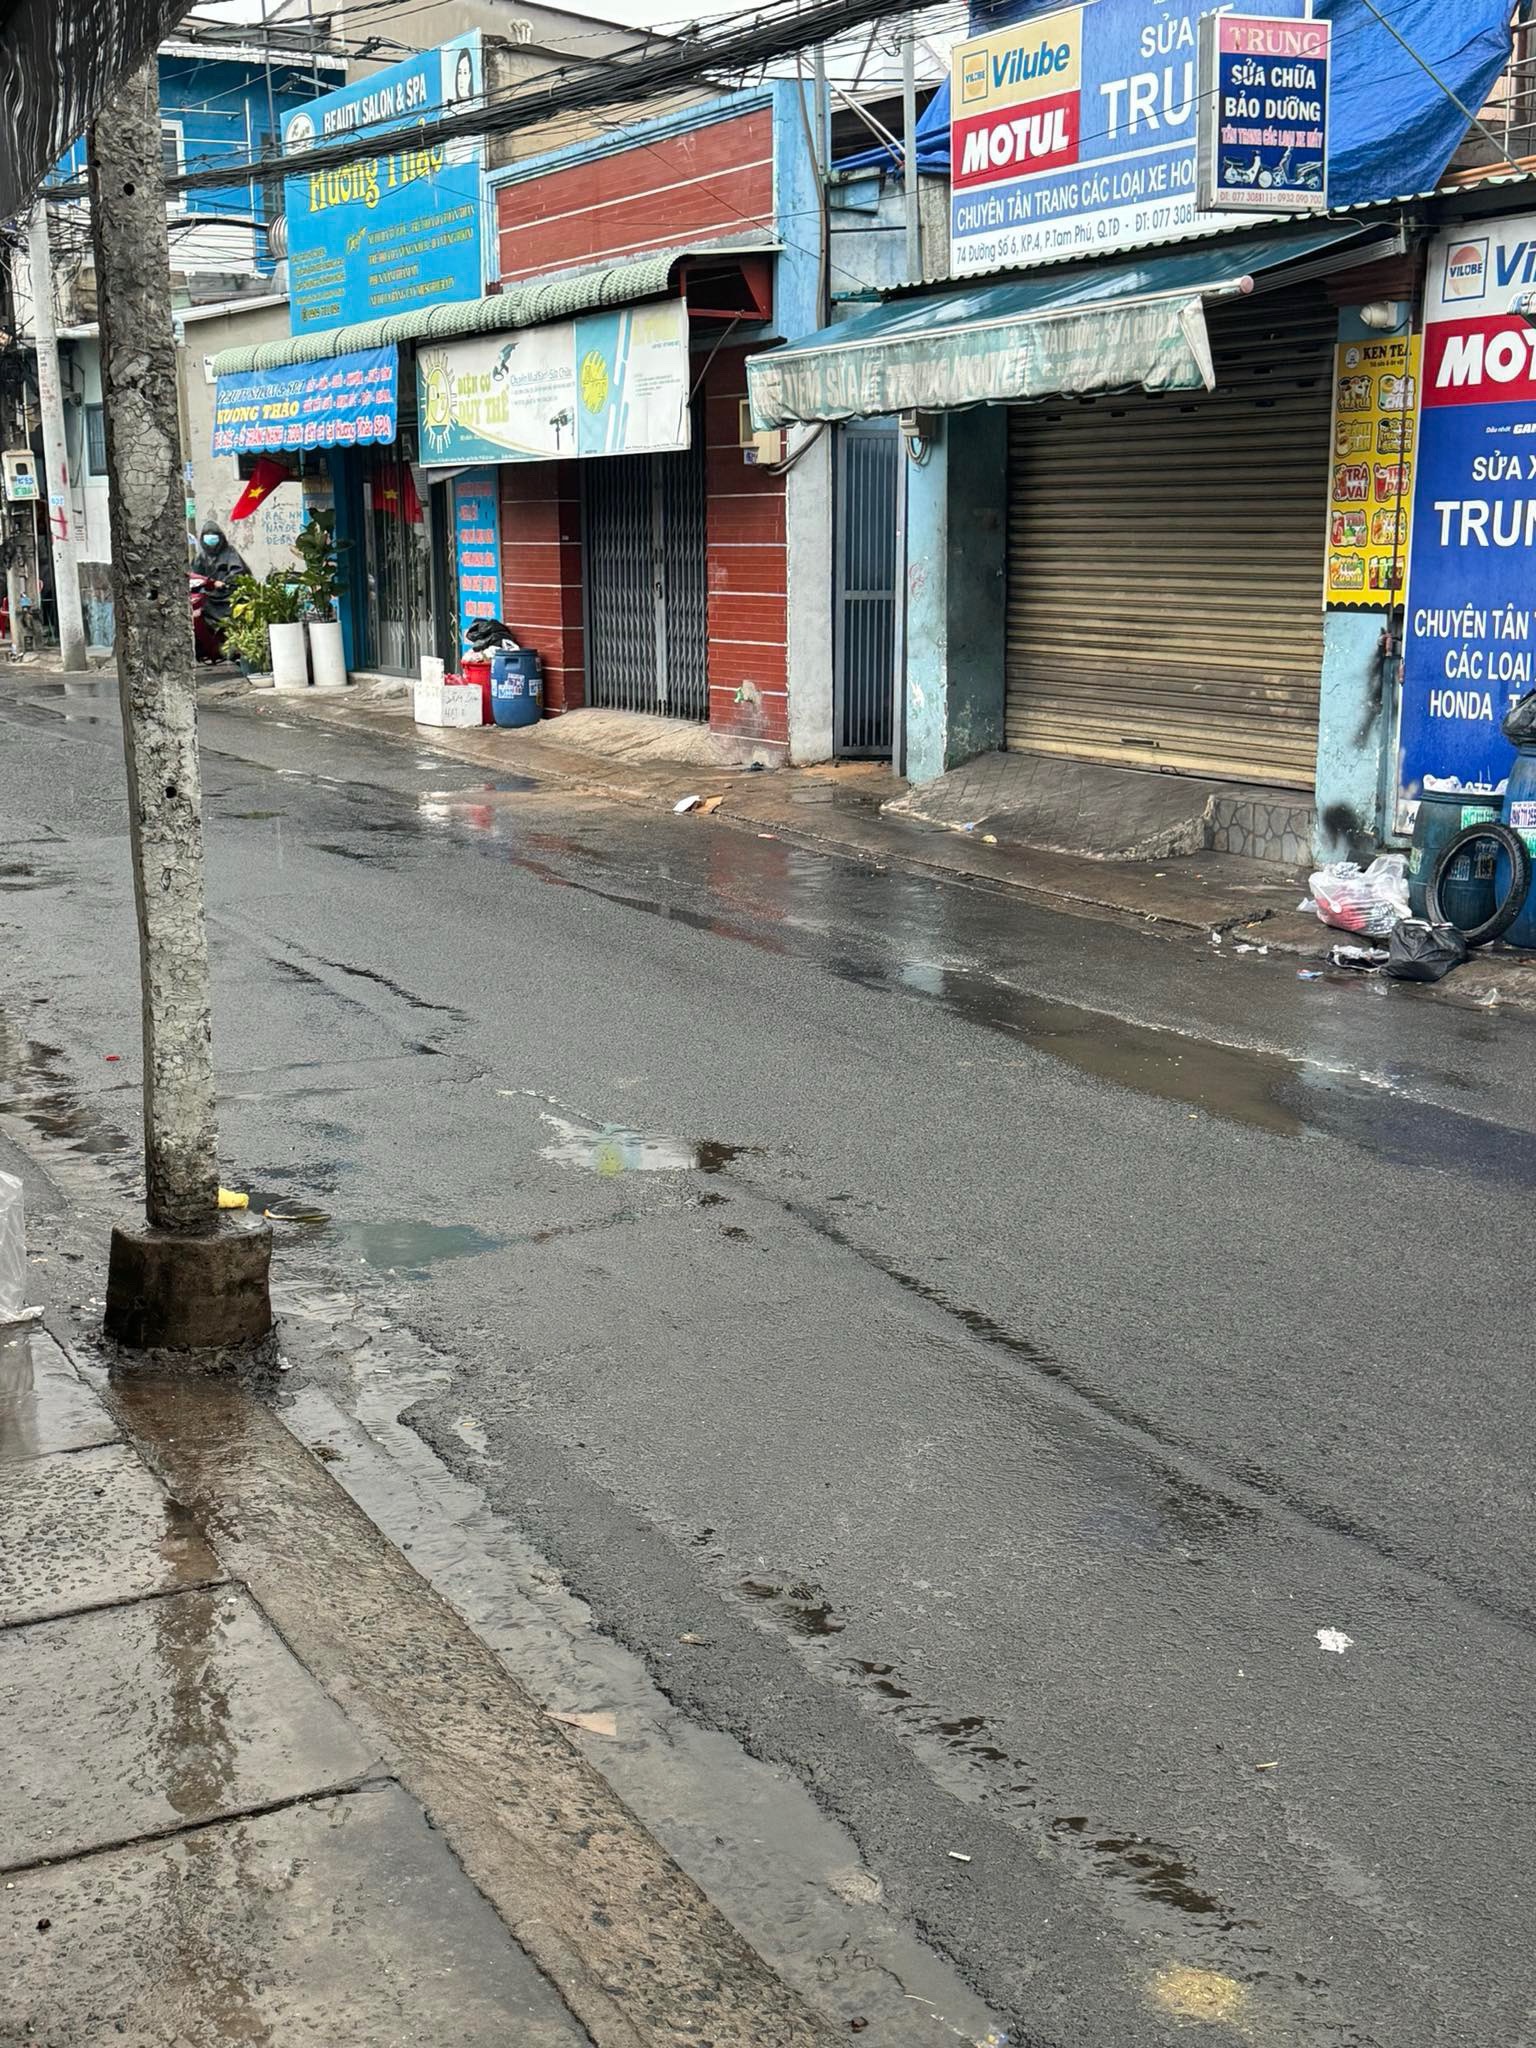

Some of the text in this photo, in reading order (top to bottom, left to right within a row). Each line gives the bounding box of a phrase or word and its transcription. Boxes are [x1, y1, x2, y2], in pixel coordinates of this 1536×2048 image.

[1140, 12, 1195, 58] SỬA
[1229, 27, 1321, 56] TRUNG
[992, 41, 1070, 89] Vilube
[1231, 58, 1317, 90] SỬA CHỮA
[323, 72, 427, 138] BEAUTY SALON & SPA
[1100, 61, 1194, 140] TRU
[1225, 90, 1321, 122] BẢO DƯỠNG
[962, 107, 1070, 176] MOTUL
[1263, 125, 1278, 147] CÁC
[957, 195, 1005, 232] CHUYÊN
[1007, 188, 1033, 221] TÂN
[1034, 183, 1079, 216] TRANG
[1081, 172, 1110, 206] CÁC
[1112, 168, 1145, 203] LOẠI
[1147, 164, 1168, 193] XE
[1152, 207, 1171, 230] 077
[1362, 345, 1388, 361] KEN
[1472, 449, 1523, 482] SỬA
[1414, 602, 1529, 640] CHUYÊN TÂN
[1445, 643, 1532, 689] CÁC LOẠI
[1429, 689, 1494, 721] HONDA
